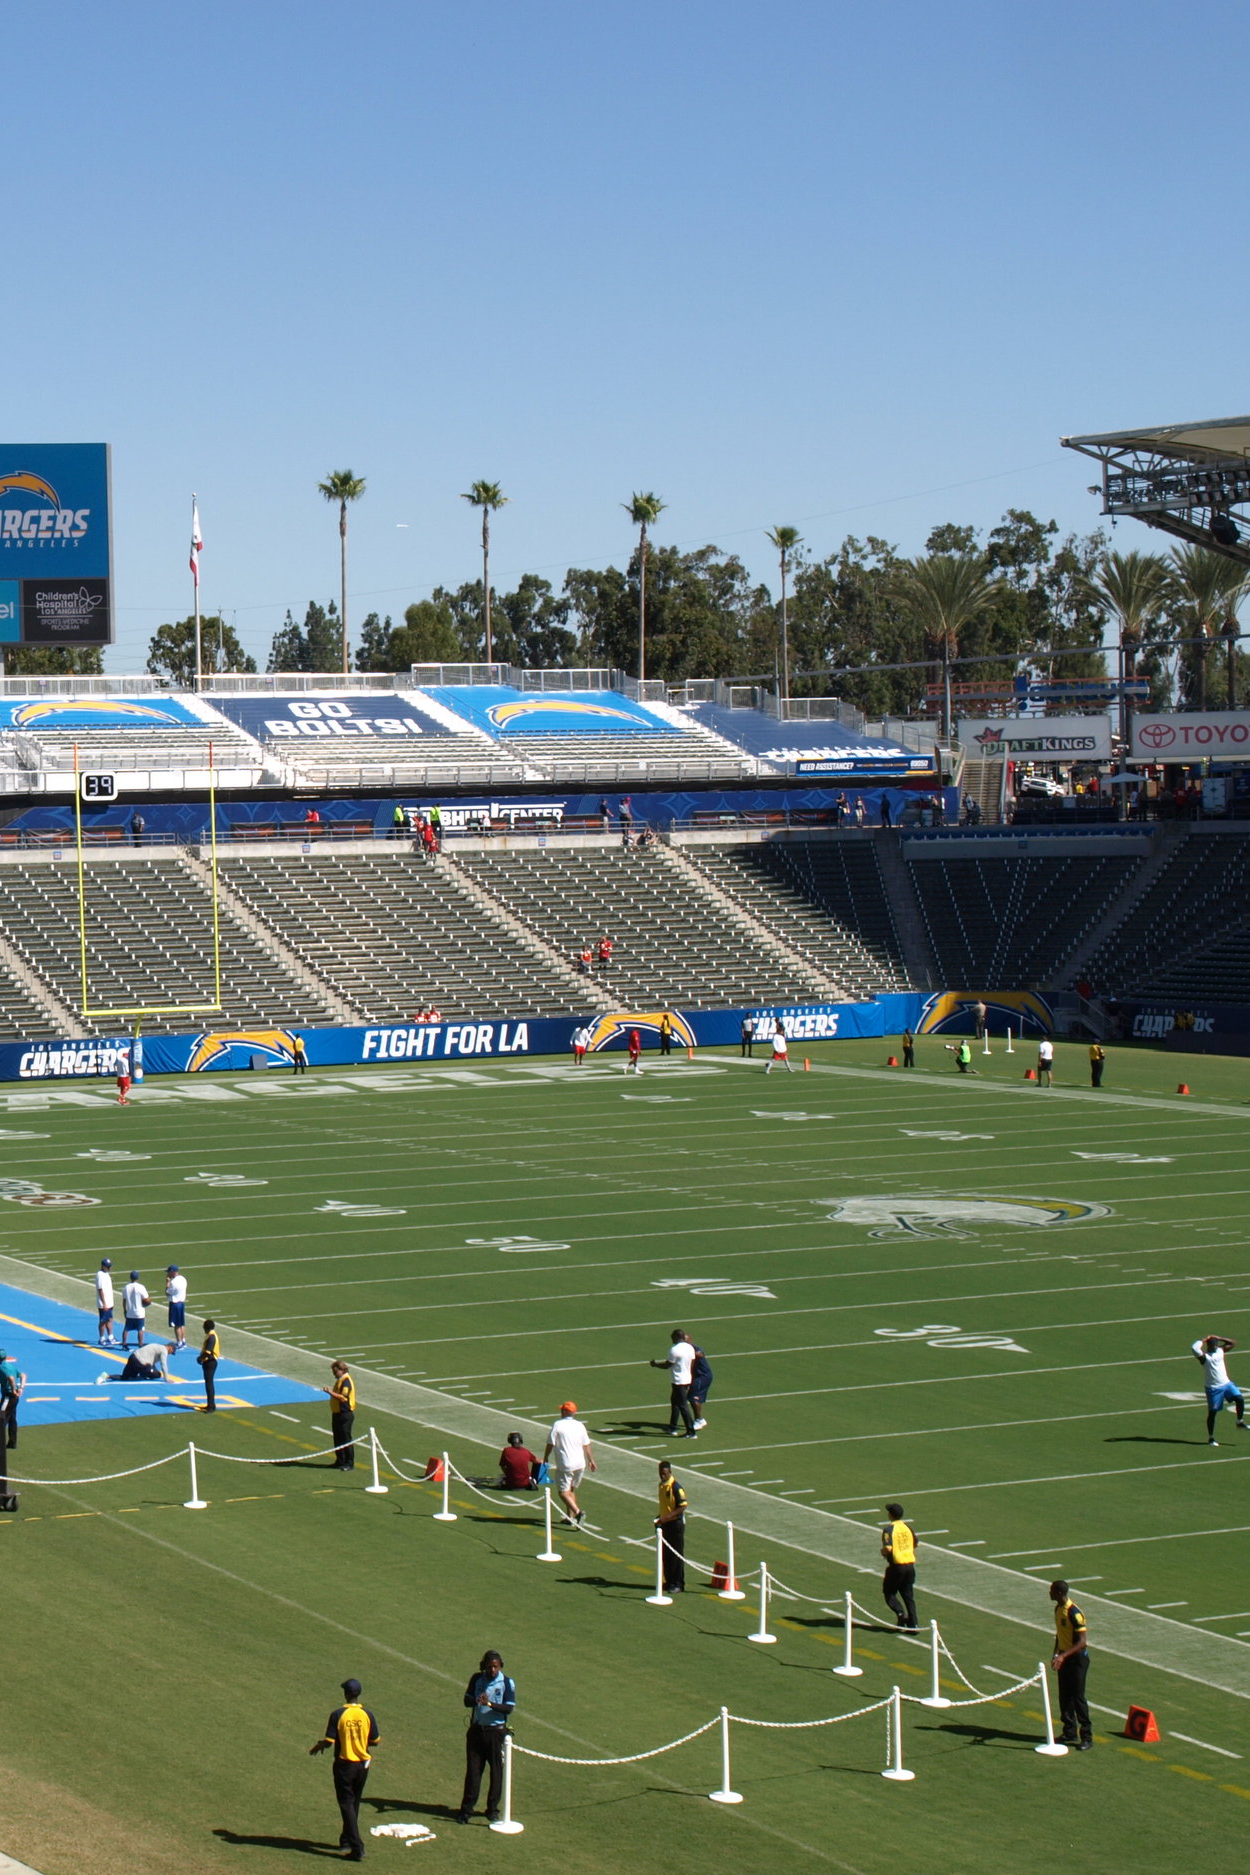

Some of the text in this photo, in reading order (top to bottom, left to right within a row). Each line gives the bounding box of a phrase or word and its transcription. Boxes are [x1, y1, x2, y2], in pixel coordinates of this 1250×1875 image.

[4, 539, 80, 549] ANGELES
[35, 591, 79, 601] Children's
[36, 600, 77, 611] Hospital
[41, 607, 87, 615] LOS ANGELES
[287, 701, 353, 718] GO
[1179, 724, 1250, 744] TOYO
[981, 736, 1096, 755] DRAFTKINGS
[800, 762, 815, 771] NEED
[815, 762, 854, 771] ASSISTANCE?
[89, 776, 112, 796] 39
[756, 1006, 831, 1018] LOS ANGELES
[31, 1040, 121, 1052] LOS ANGELES
[362, 1022, 529, 1059] FIGHT FOR LA
[19, 1046, 131, 1078] CHARGERS
[464, 1235, 572, 1253] 50
[872, 1324, 1015, 1348] 30
[345, 1719, 363, 1728] CSC
[1130, 1709, 1149, 1738] G
